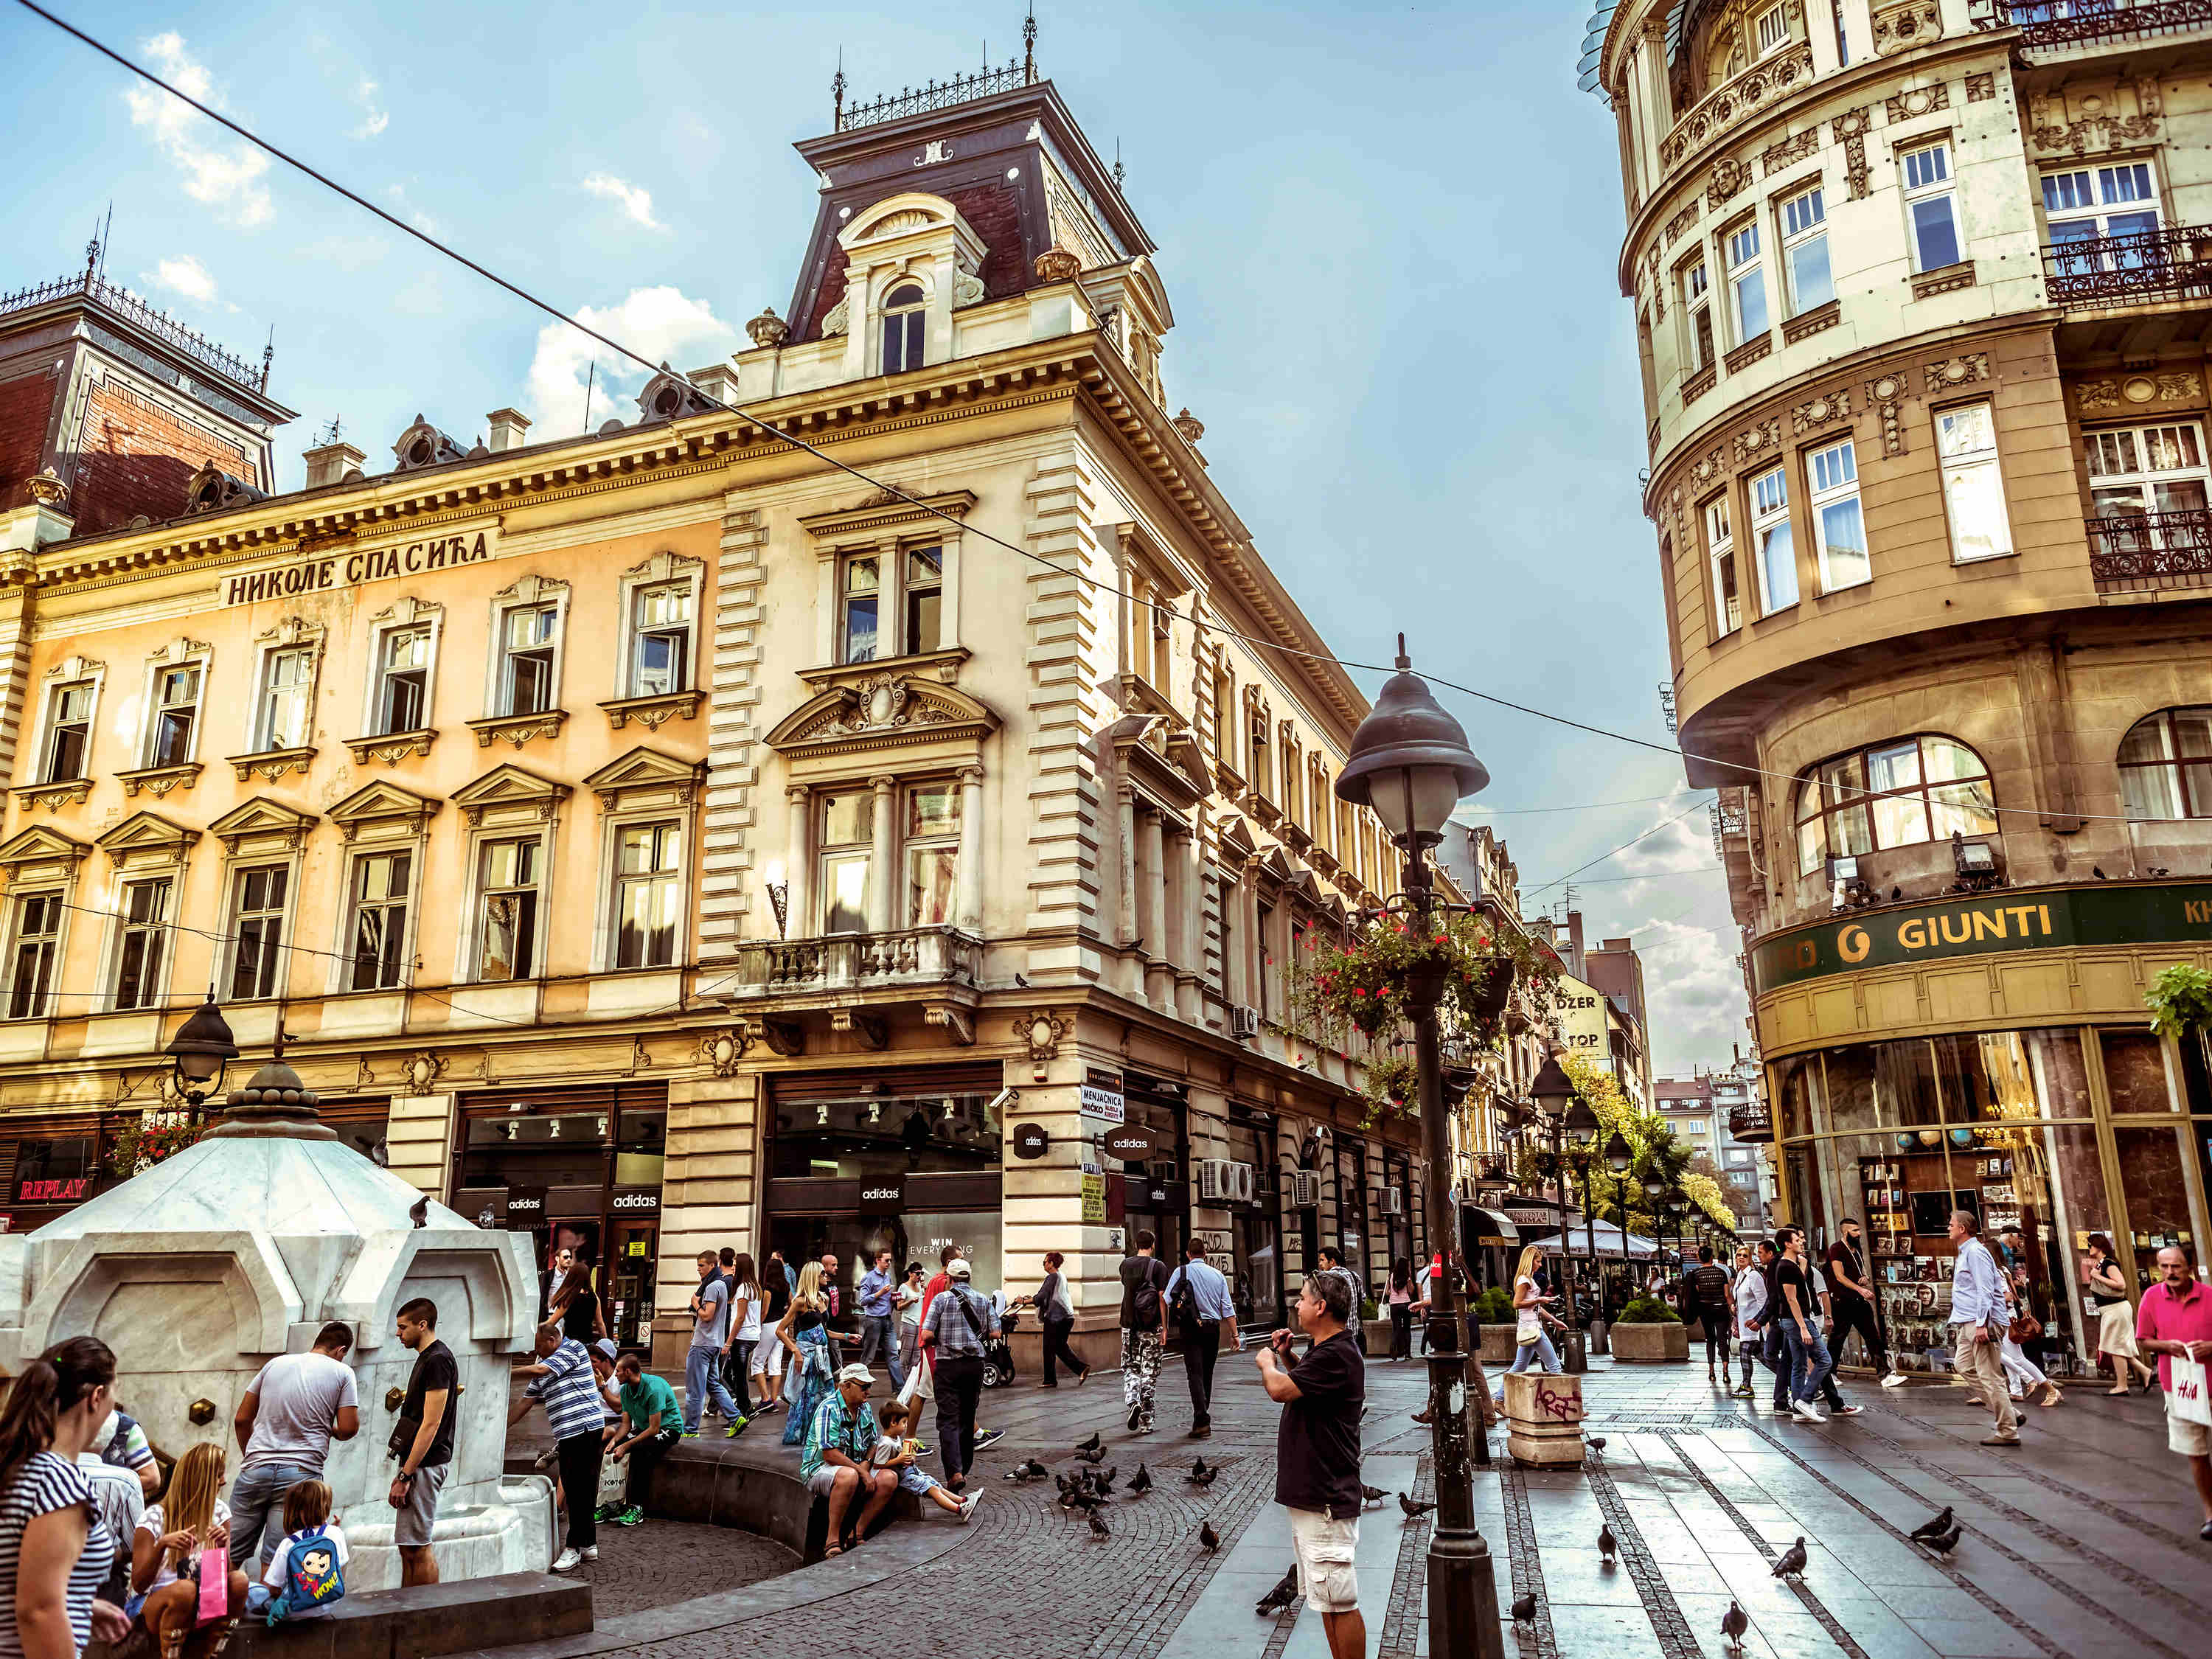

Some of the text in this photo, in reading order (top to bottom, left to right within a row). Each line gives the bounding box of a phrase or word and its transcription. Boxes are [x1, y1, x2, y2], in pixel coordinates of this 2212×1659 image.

[227, 532, 488, 605] НИКОЛЕ СПАСИЋА
[1898, 905, 2053, 950] GIUNTI
[1026, 1136, 1042, 1146] adidas
[1113, 1139, 1148, 1148] adidas
[19, 1179, 87, 1200] REPLAY
[863, 1188, 900, 1199] adidas
[509, 1198, 540, 1210] adidas
[613, 1194, 656, 1208] adidas
[931, 1238, 953, 1246] WIN
[910, 1245, 973, 1255] EVERYNG
[313, 1571, 338, 1599] WOW!
